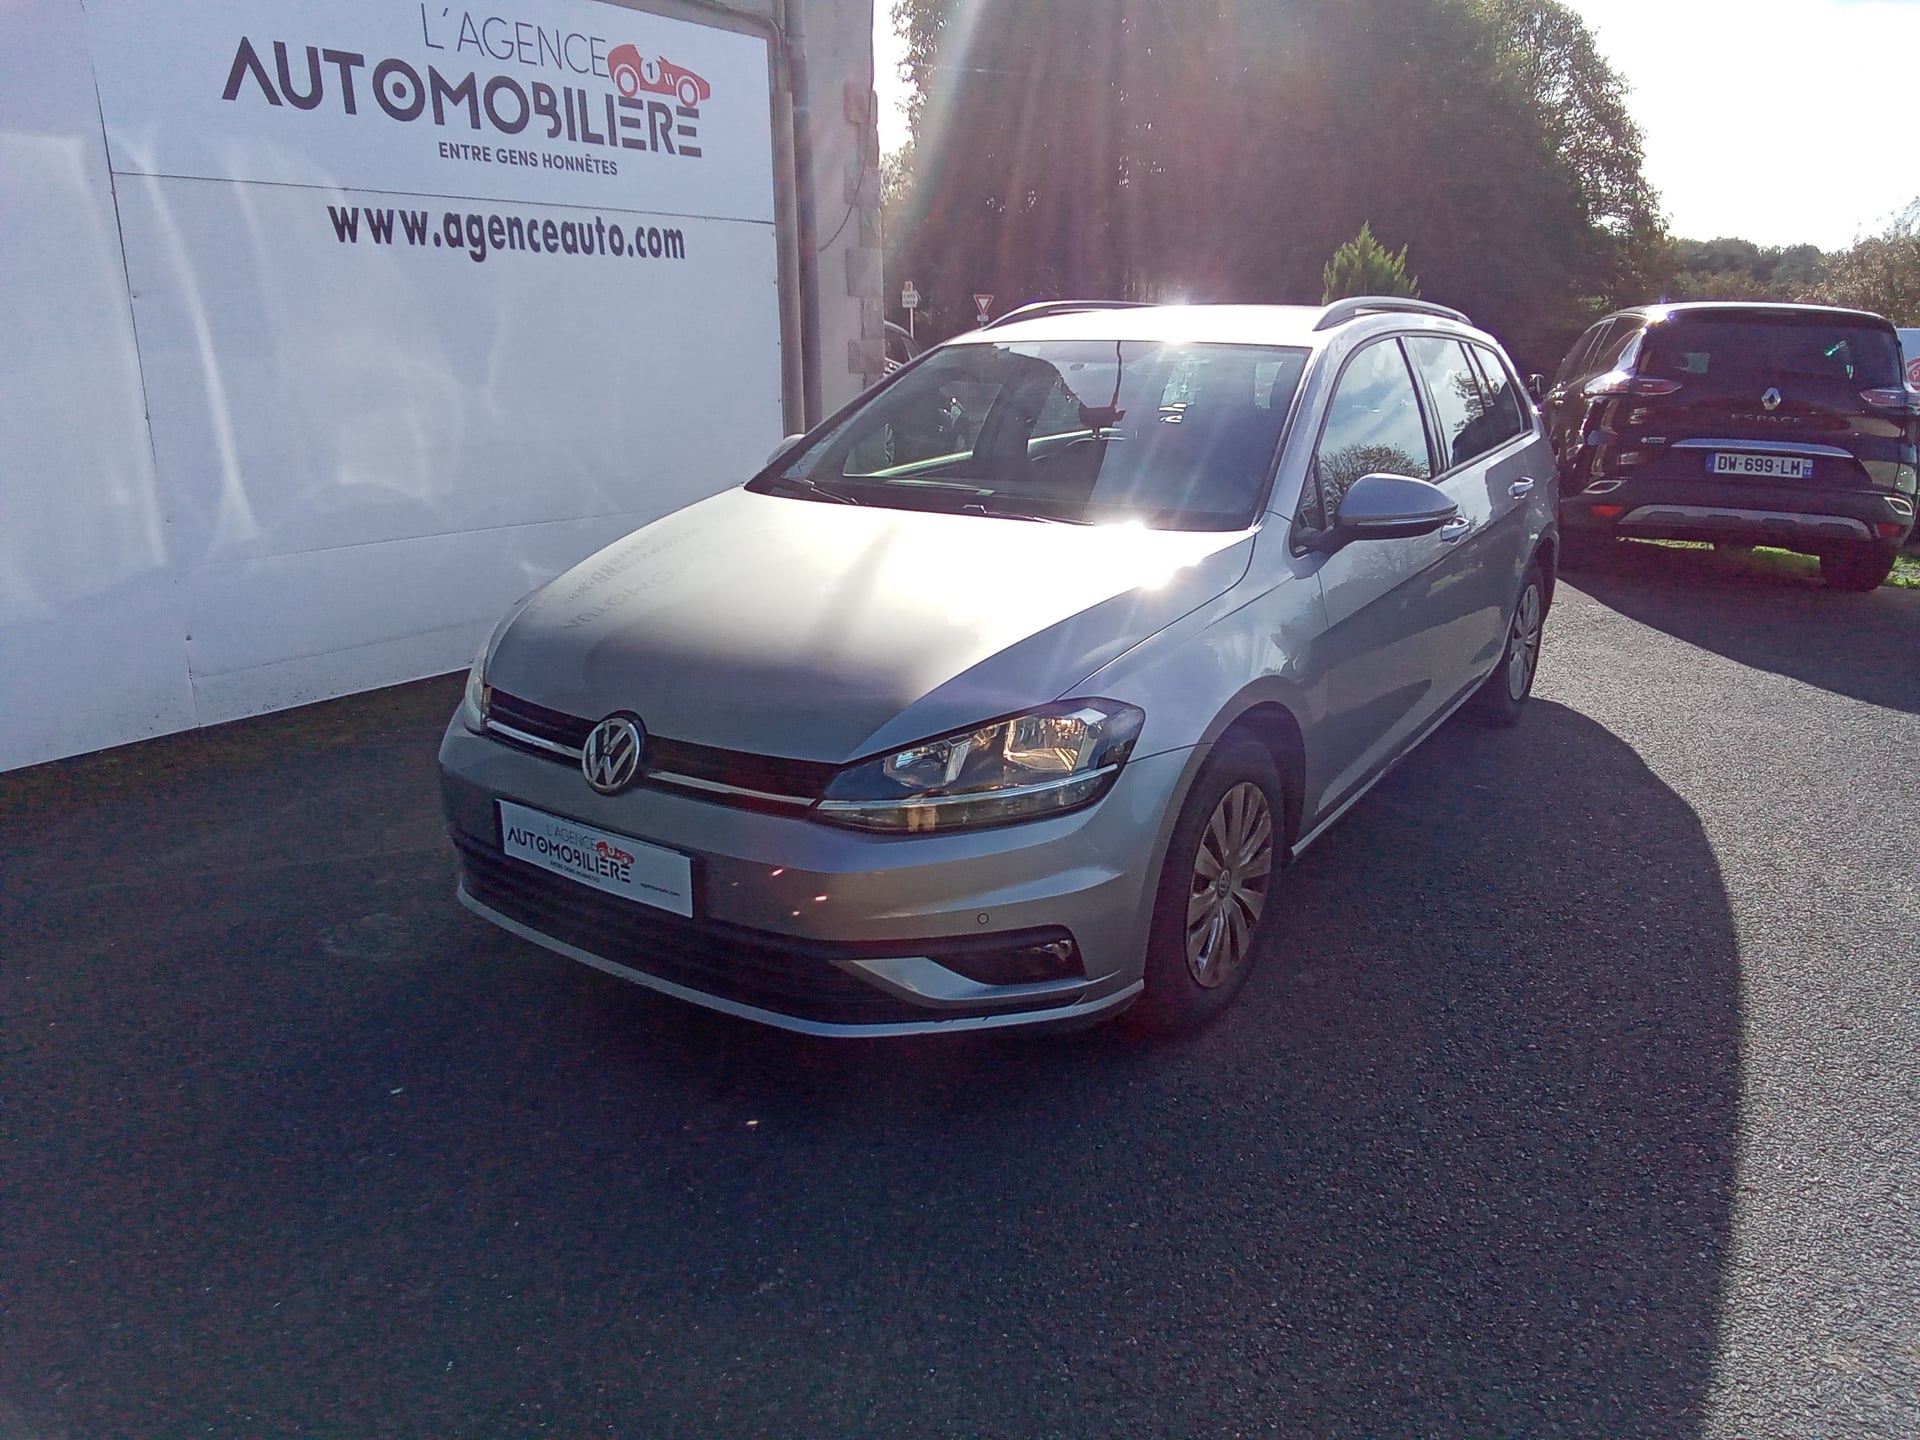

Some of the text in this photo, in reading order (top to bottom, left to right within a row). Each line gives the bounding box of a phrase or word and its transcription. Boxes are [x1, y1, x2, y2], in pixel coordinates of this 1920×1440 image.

[421, 2, 609, 78] L'AGENCE
[439, 142, 618, 176] ENTRE GENS HONNÊTES
[327, 204, 686, 262] www.agenceauto.com
[1717, 455, 1801, 476] DW-699-LM
